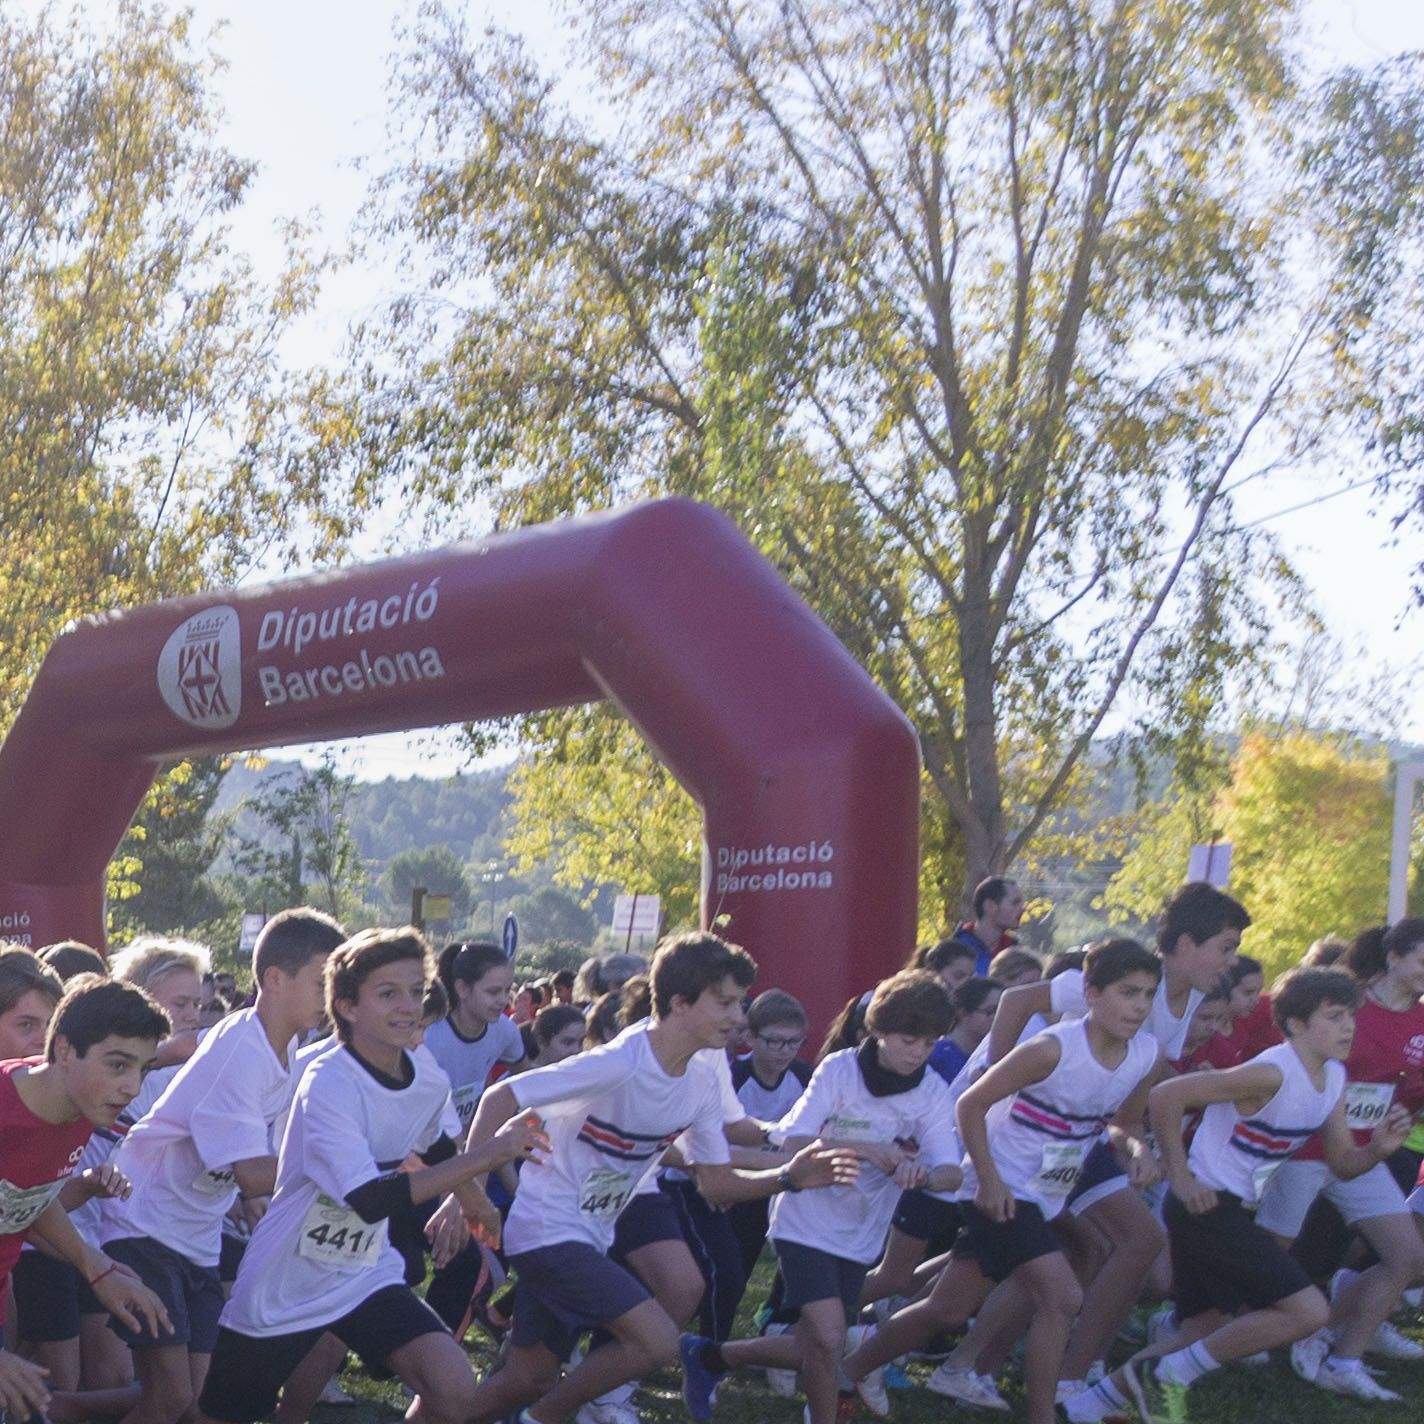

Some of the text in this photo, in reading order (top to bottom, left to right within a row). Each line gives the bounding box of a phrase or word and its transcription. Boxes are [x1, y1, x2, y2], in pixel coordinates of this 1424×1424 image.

[257, 576, 441, 654] Diputació
[258, 646, 446, 705] Barcelona
[718, 840, 834, 869] Diputació
[717, 868, 833, 894] Barcelona
